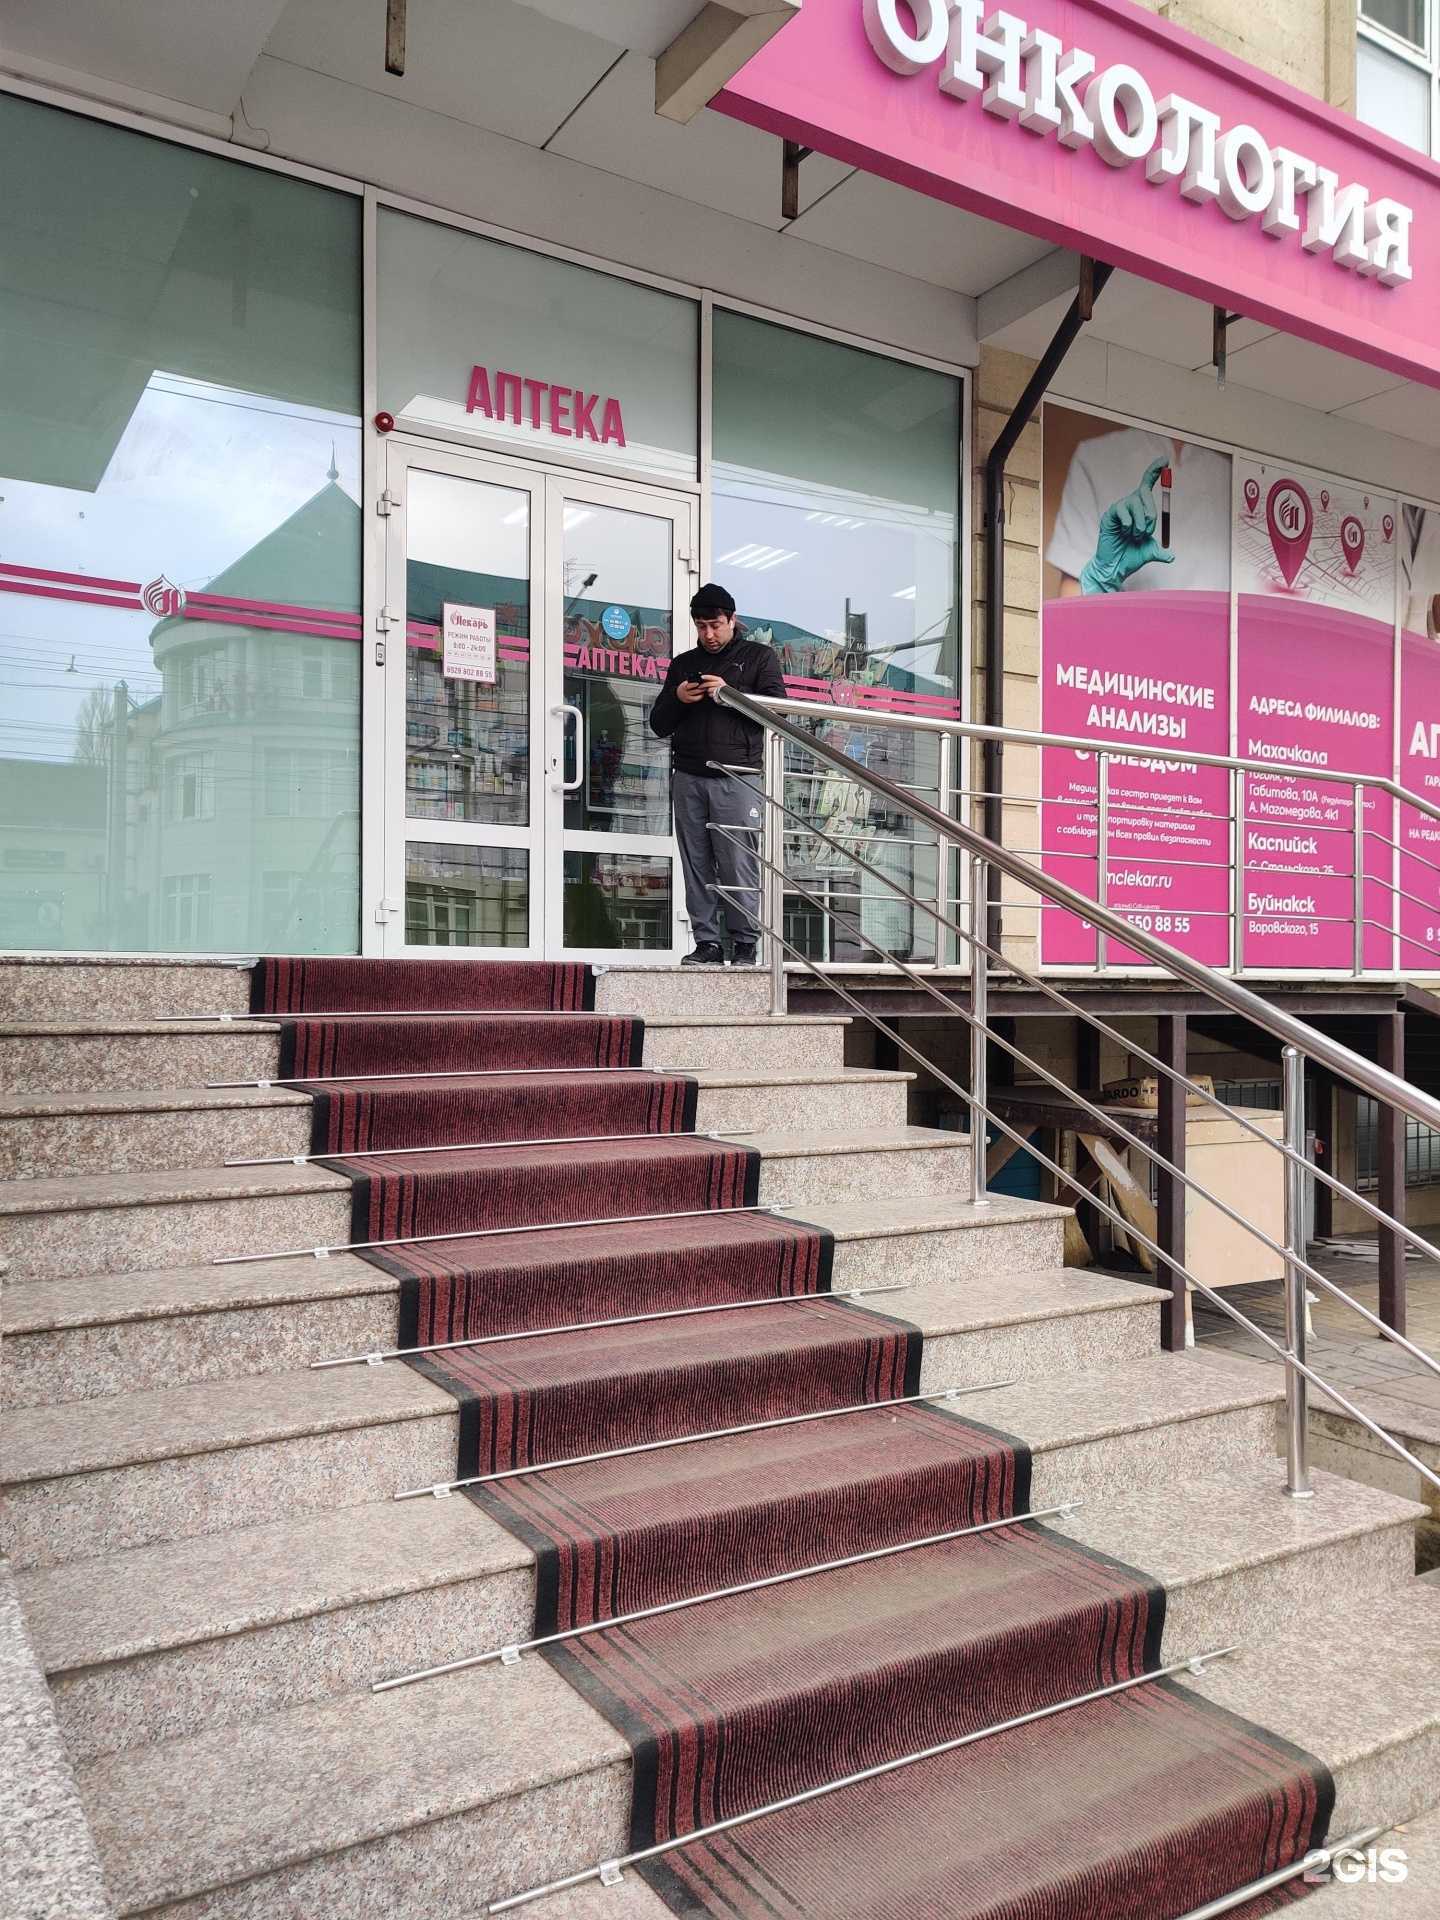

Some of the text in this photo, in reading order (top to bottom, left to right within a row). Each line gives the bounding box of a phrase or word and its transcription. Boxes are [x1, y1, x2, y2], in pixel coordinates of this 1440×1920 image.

[863, 0, 1413, 288] ОНКОЛОГИЯ
[465, 365, 627, 448] АПТЕКА
[578, 645, 658, 680] АПТЕКА
[1056, 663, 1215, 710] МЕДИЦИНСКИЕ
[1086, 704, 1187, 739] АНАЛИЗЫ
[1249, 695, 1381, 729] АДРЕСА ФИЛИАЛОВ:
[1248, 739, 1328, 765] Махачкала
[1249, 783, 1301, 802] Габитова,
[1260, 802, 1324, 821] Магомедова,
[1248, 831, 1318, 854] Каспийск
[1248, 892, 1316, 914] Буйнакск
[1155, 915, 1172, 932] 88
[1174, 917, 1190, 933] 55
[1249, 920, 1319, 936] Воровского, 15
[1426, 926, 1434, 942] 8
